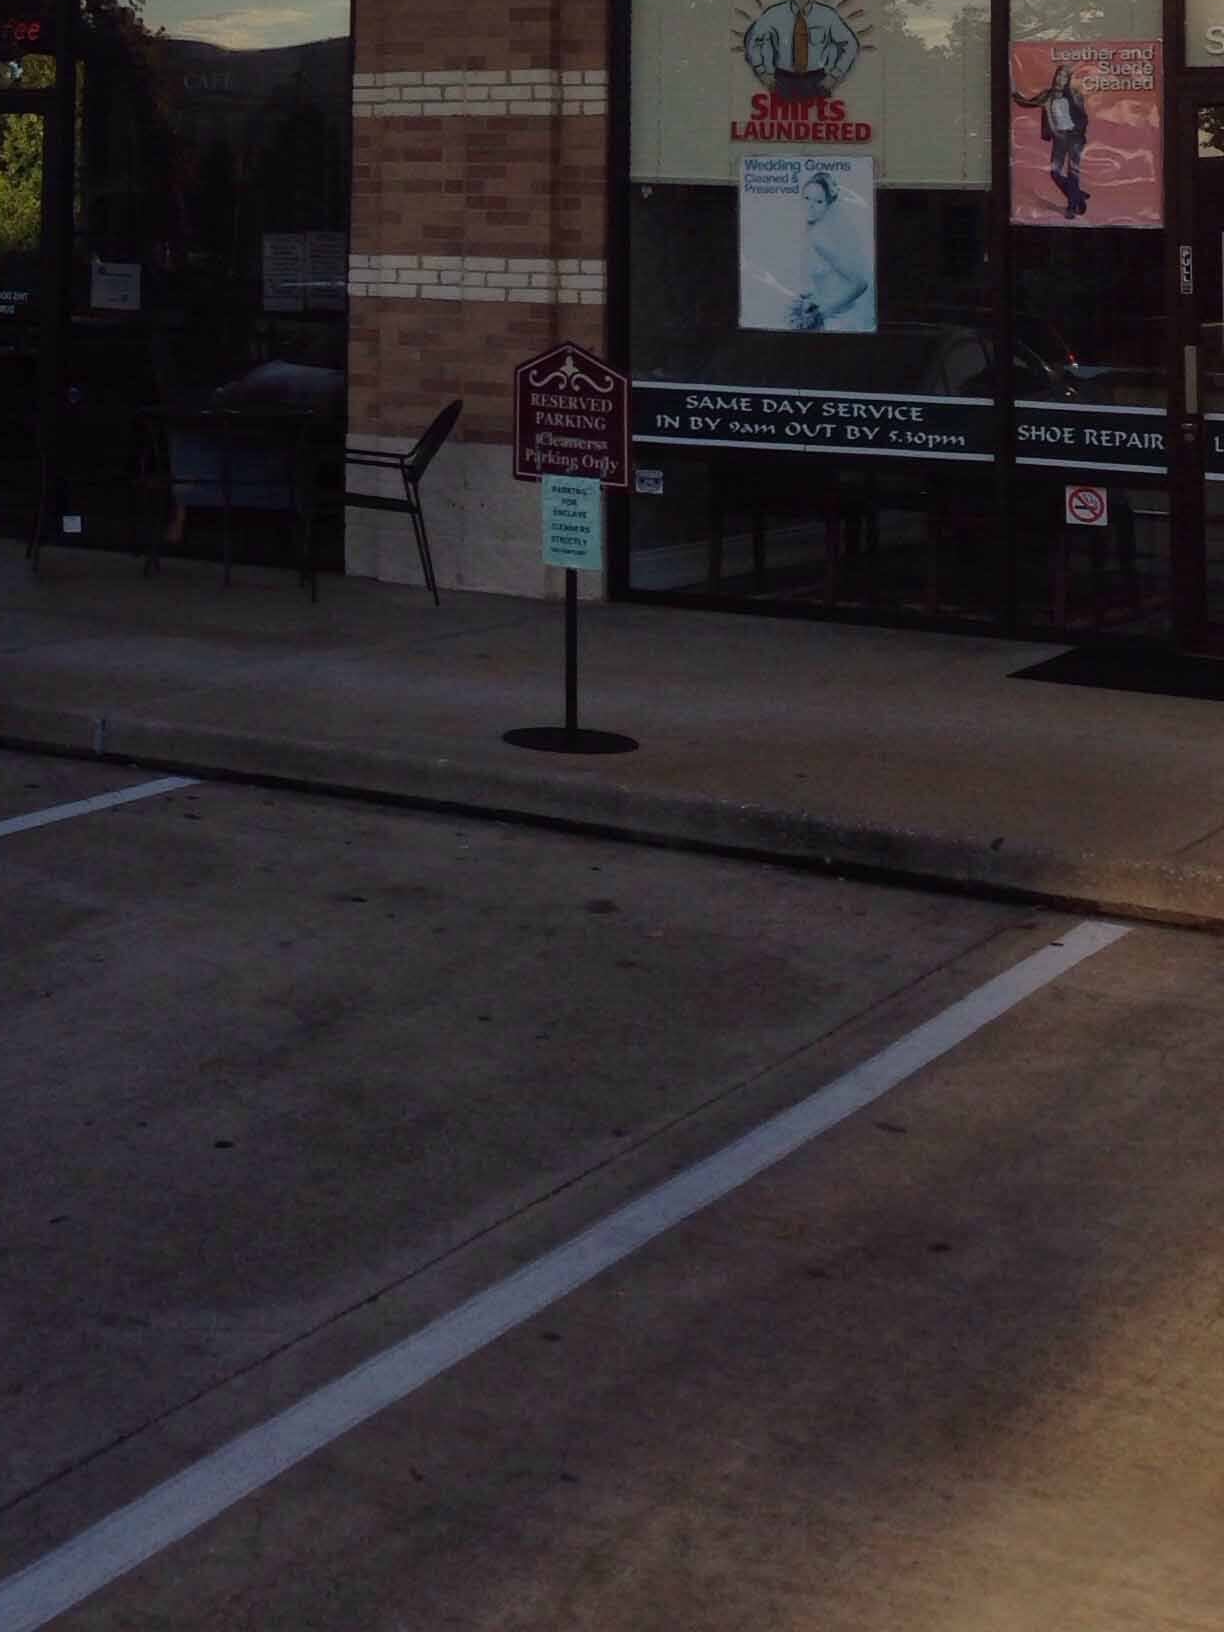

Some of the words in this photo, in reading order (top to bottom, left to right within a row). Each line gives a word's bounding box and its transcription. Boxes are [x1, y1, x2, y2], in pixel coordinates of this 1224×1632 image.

[1051, 47, 1115, 61] Leather
[1121, 48, 1154, 60] and
[1097, 61, 1154, 75] Suede
[1080, 76, 1154, 91] Cleaned
[730, 120, 872, 141] LAUNDERED
[744, 159, 801, 173] Wedding
[804, 159, 852, 171] Gowns
[744, 173, 789, 185] Cleaned
[744, 183, 800, 194] Preserved
[530, 392, 614, 414] RESERVED
[685, 394, 753, 412] SAME
[761, 399, 815, 415] DAY
[821, 402, 925, 422] SERVICE
[536, 411, 607, 432] PARKING
[655, 414, 680, 430] IN
[689, 416, 722, 432] BY
[729, 421, 776, 436] 9am
[784, 421, 838, 438] OUT
[845, 425, 881, 441] BY
[888, 429, 966, 449] 5.30pm
[1016, 424, 1076, 445] SHOE
[1082, 428, 1166, 451] REPAIR
[525, 448, 580, 472] Parking
[581, 454, 618, 476] Only
